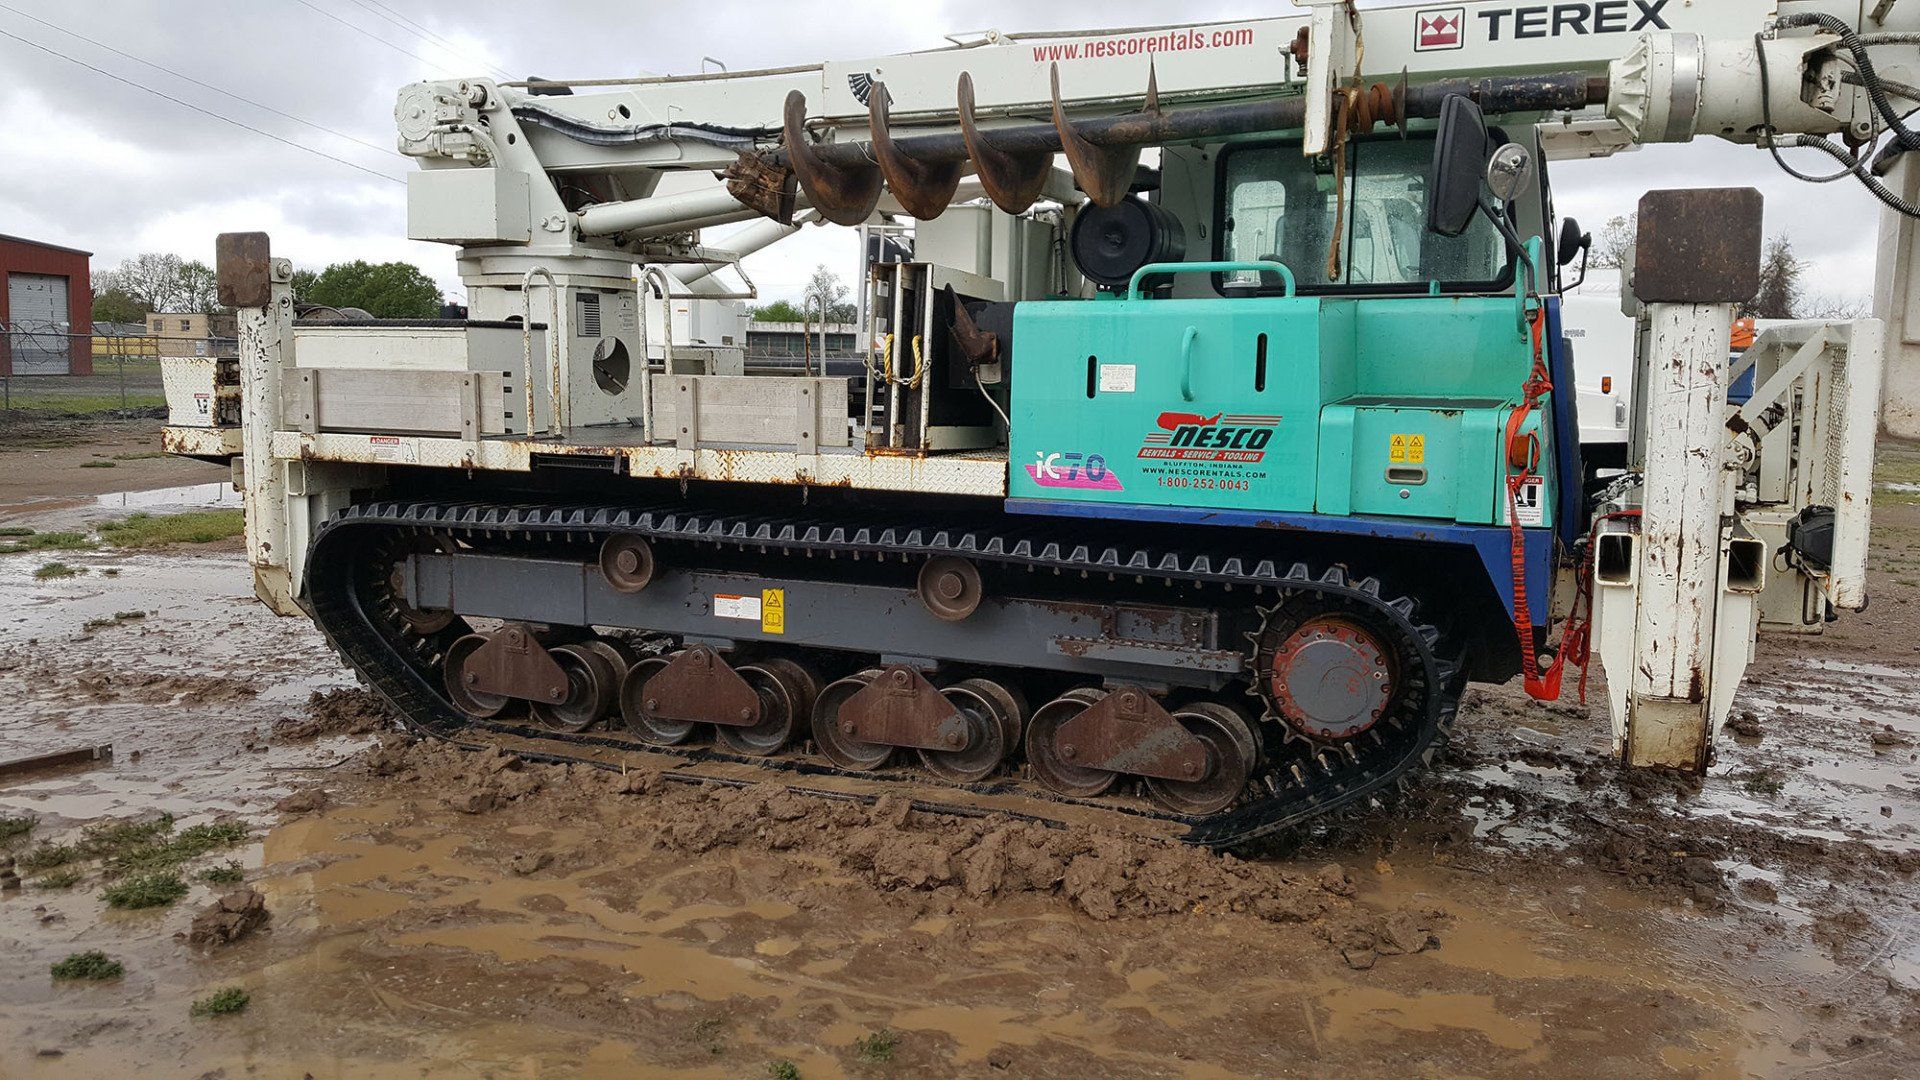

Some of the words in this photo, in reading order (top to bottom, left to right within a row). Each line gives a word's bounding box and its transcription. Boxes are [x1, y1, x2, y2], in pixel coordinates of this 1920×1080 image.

[1478, 0, 1672, 41] TEREX
[1033, 28, 1253, 62] www.nescorentals.com
[1169, 426, 1273, 450] NESCO
[1141, 449, 1177, 457] RENTALS
[1223, 452, 1259, 461] TOOLING
[1142, 467, 1267, 479] WWW.NESCORENTALS.COM
[1157, 476, 1249, 491] 1-800-252-0043
